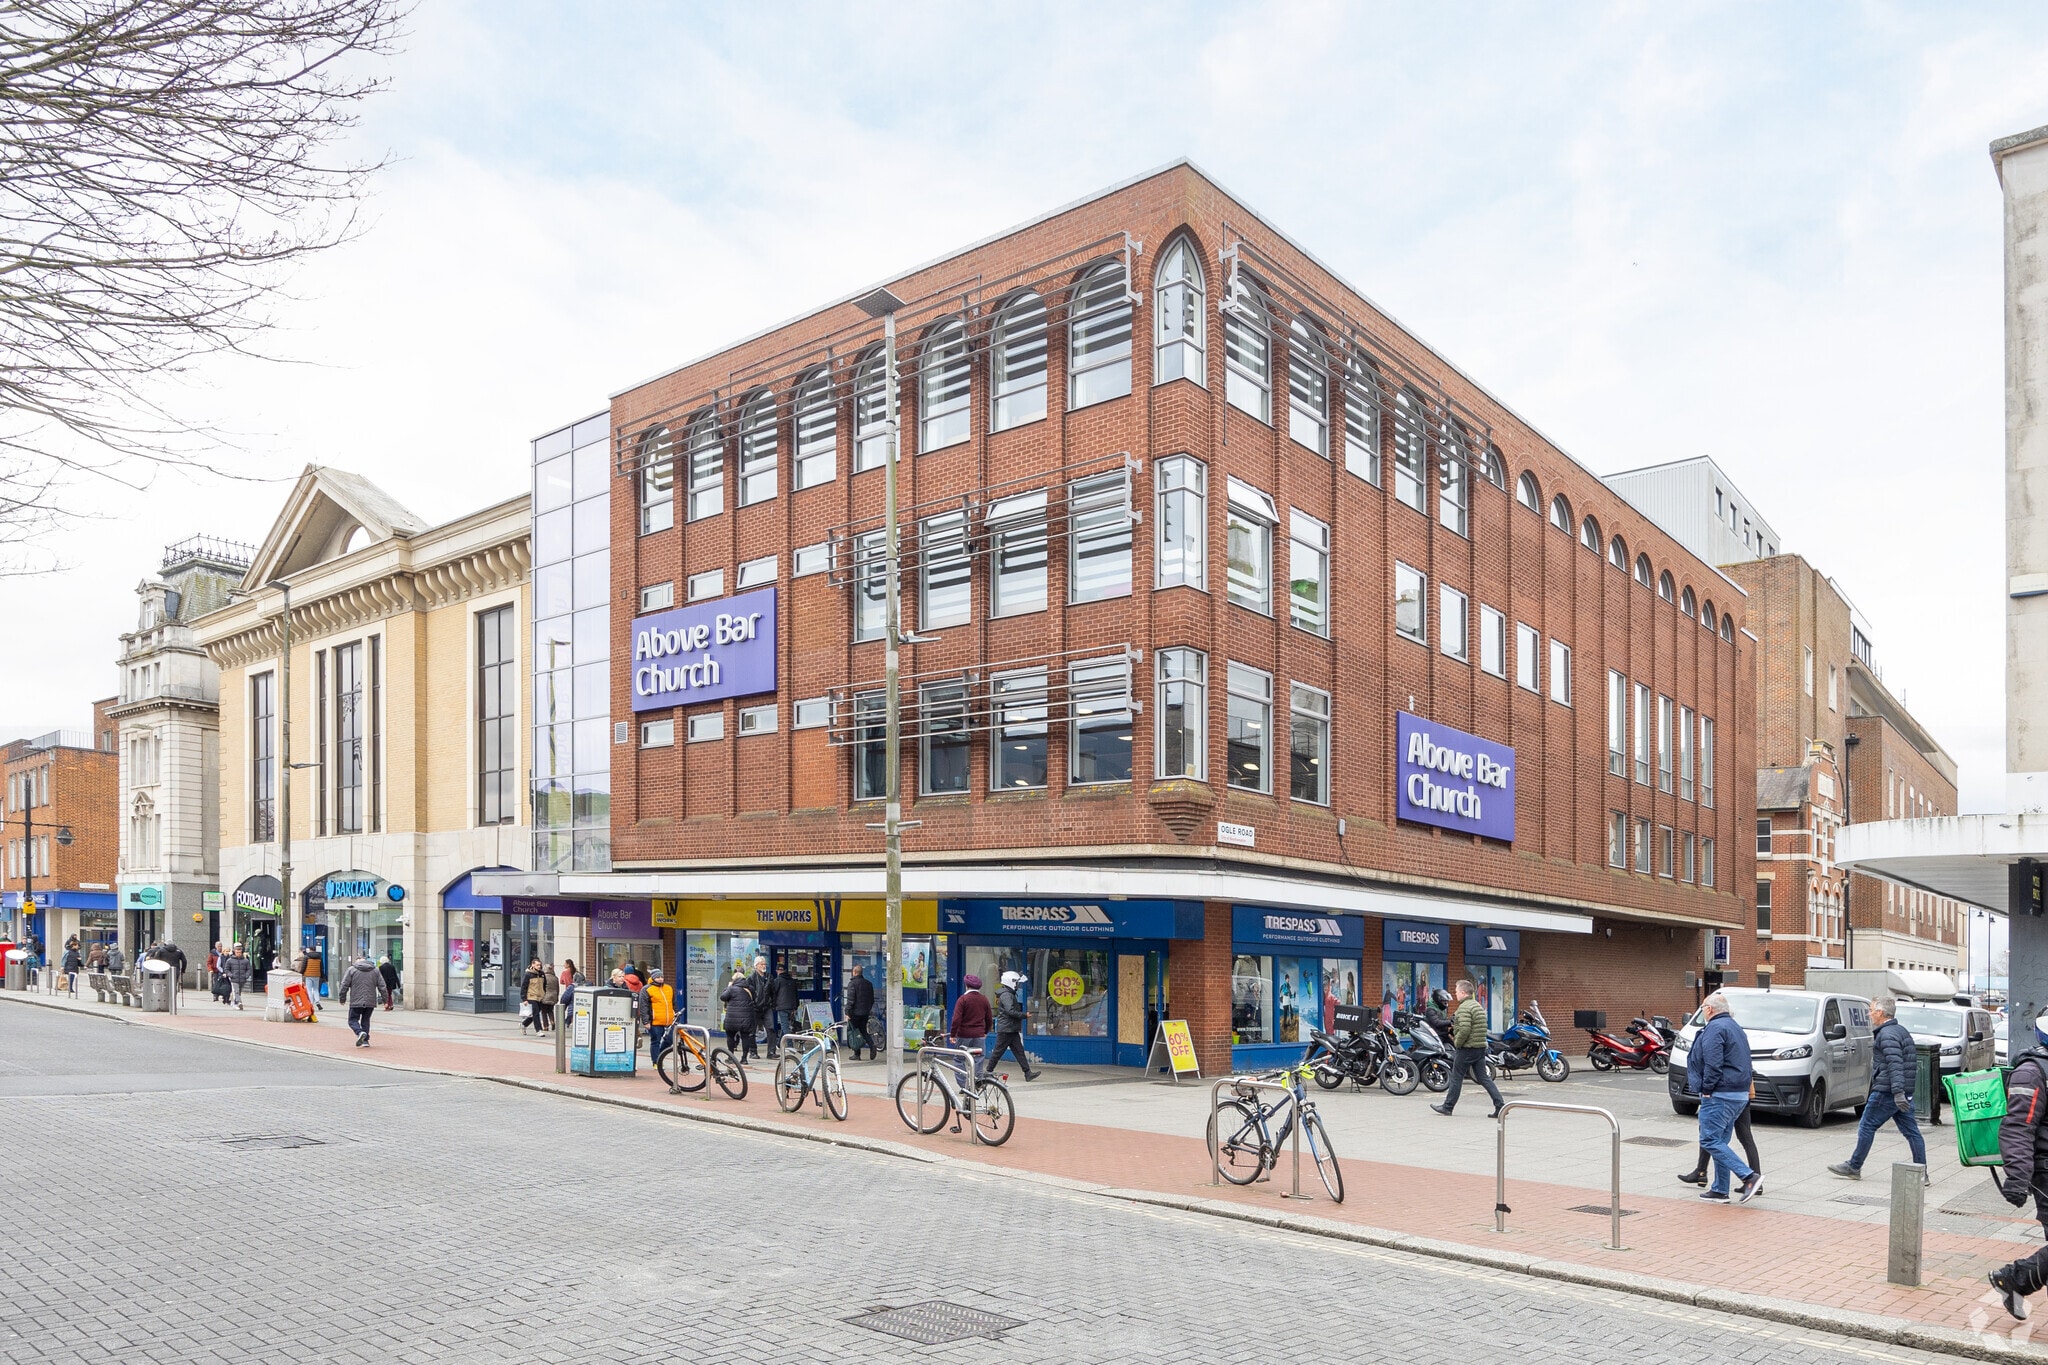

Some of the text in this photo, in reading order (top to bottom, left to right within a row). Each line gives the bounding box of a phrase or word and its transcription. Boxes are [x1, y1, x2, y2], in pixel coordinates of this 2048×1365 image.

[635, 612, 762, 661] Above Bar
[635, 653, 720, 697] Church
[1407, 732, 1511, 789] Above Bar
[1407, 773, 1481, 820] Church
[1220, 825, 1254, 838] OGLE ROAD
[335, 881, 377, 898] BARCLAYS
[236, 890, 275, 912] FOOTASYLUM
[512, 899, 548, 908] Above Bar
[512, 906, 538, 914] Church
[597, 909, 632, 920] Above Bar
[756, 909, 812, 923] THE WORKS
[999, 905, 1070, 921] TRESPASS
[597, 920, 621, 930] Church
[656, 917, 677, 925] WORKS
[1263, 915, 1317, 933] TRESPASS
[1399, 930, 1440, 945] TRESPASS
[1053, 976, 1081, 988] 60%
[1053, 987, 1079, 998] OFF
[1335, 1012, 1359, 1021] BIKE IT
[1168, 1032, 1189, 1046] 60%
[1170, 1044, 1190, 1057] OFF
[1965, 1091, 1989, 1102] Uber
[1966, 1100, 1992, 1111] Eats
